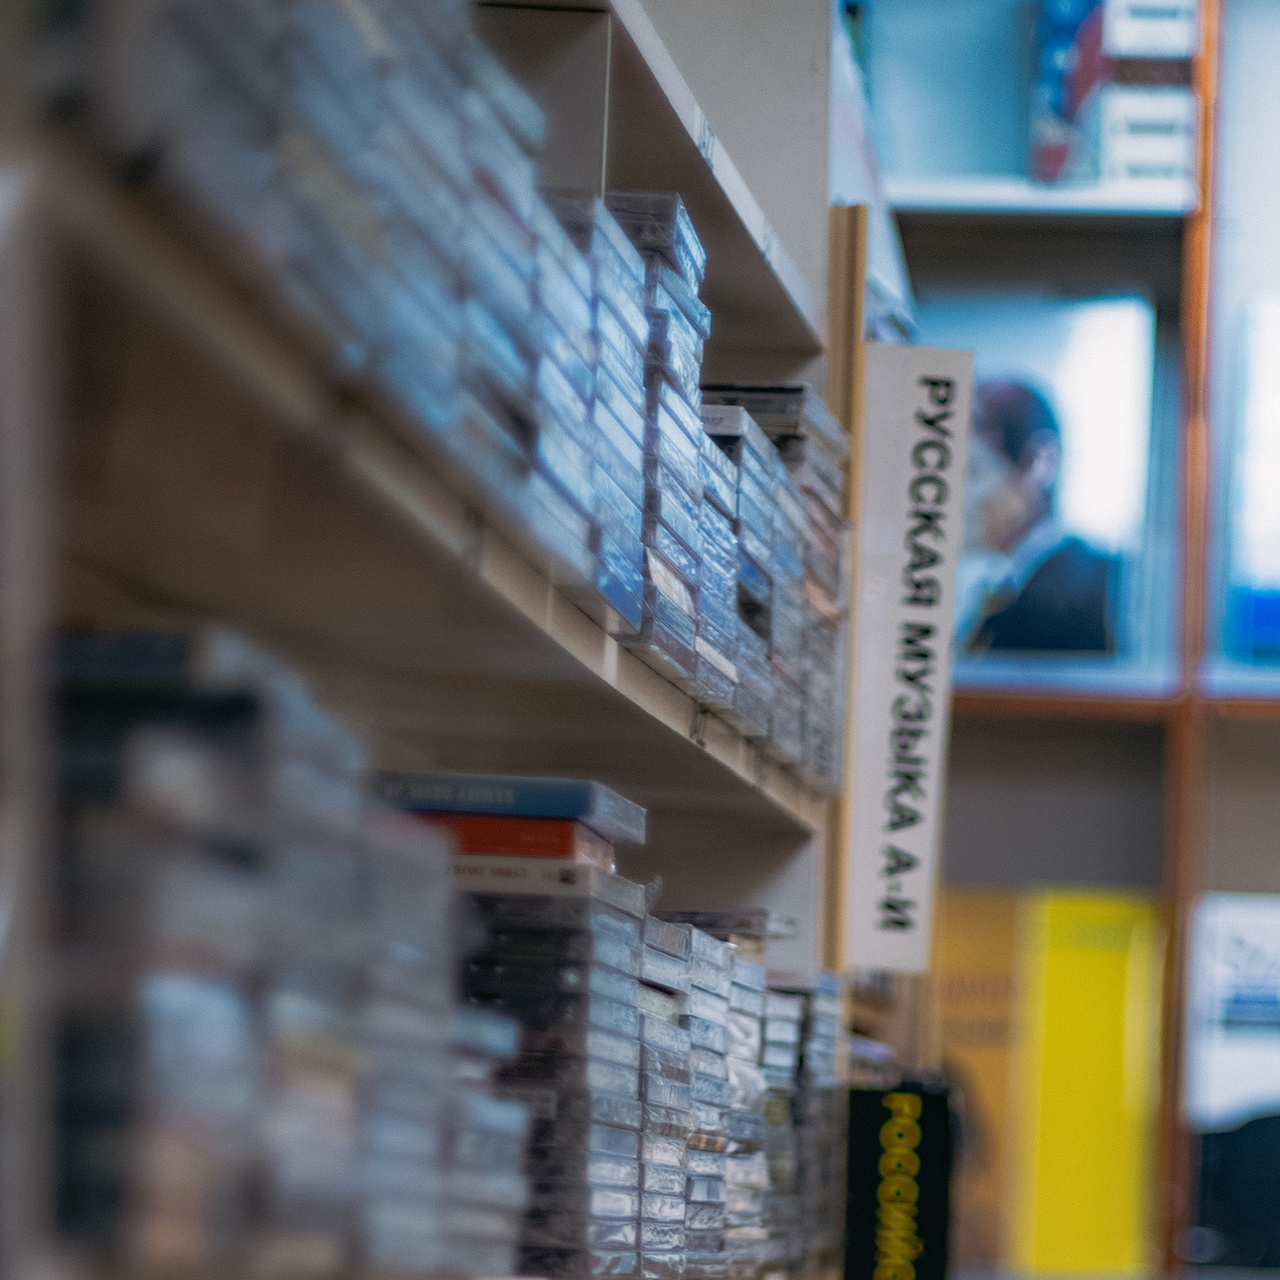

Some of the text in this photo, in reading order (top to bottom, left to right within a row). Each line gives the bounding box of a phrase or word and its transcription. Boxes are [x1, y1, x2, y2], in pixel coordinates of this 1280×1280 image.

[874, 375, 957, 933] РУССКАЯ МУЗЫКА А-И
